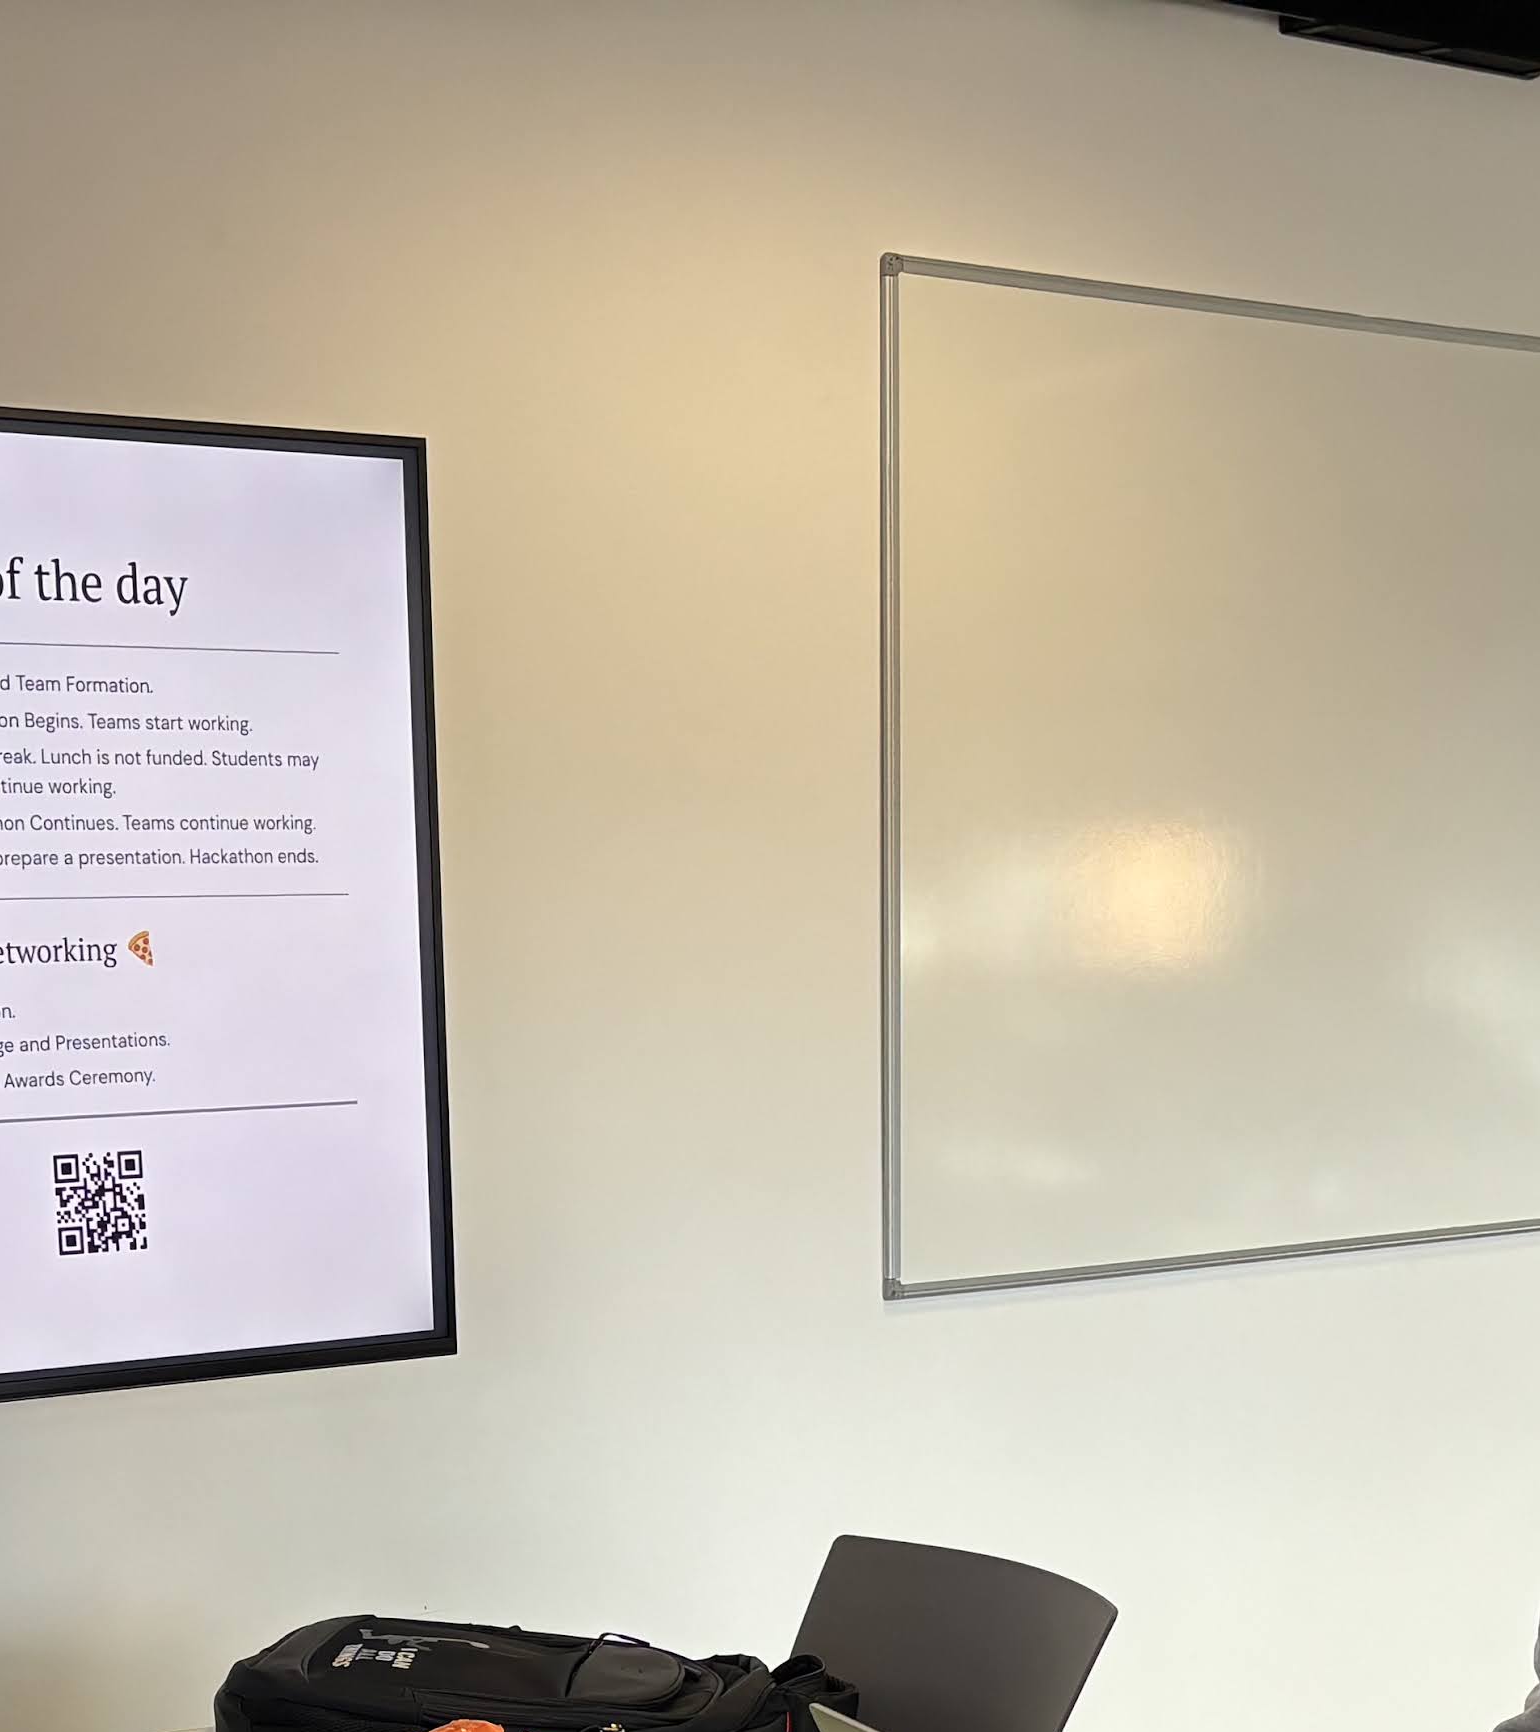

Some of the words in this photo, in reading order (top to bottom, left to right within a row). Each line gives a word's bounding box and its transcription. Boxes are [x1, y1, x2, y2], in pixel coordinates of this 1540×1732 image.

[34, 558, 102, 603] the
[116, 561, 189, 617] day
[15, 674, 61, 692] Team
[66, 675, 154, 694] Formation.
[24, 711, 83, 734] Begins.
[87, 712, 141, 730] Teams
[145, 716, 184, 731] start
[188, 715, 253, 736] working.
[41, 748, 92, 765] Lunch
[96, 748, 110, 765] is
[114, 751, 142, 766] not
[146, 748, 207, 766] funded.
[212, 750, 283, 767] Students
[287, 755, 320, 771] may
[47, 777, 116, 799] working.
[29, 814, 119, 831] Continues.
[122, 814, 175, 831] Teams
[179, 814, 249, 831] continue
[253, 814, 316, 835] working.
[64, 853, 74, 865] a
[78, 848, 185, 870] presentation.
[190, 847, 273, 865] Hackathon
[277, 847, 319, 864] ends.
[19, 1035, 51, 1052] and
[55, 1031, 170, 1051] Presentations.
[4, 1071, 65, 1089] Awards
[69, 1069, 156, 1087] Ceremony.
